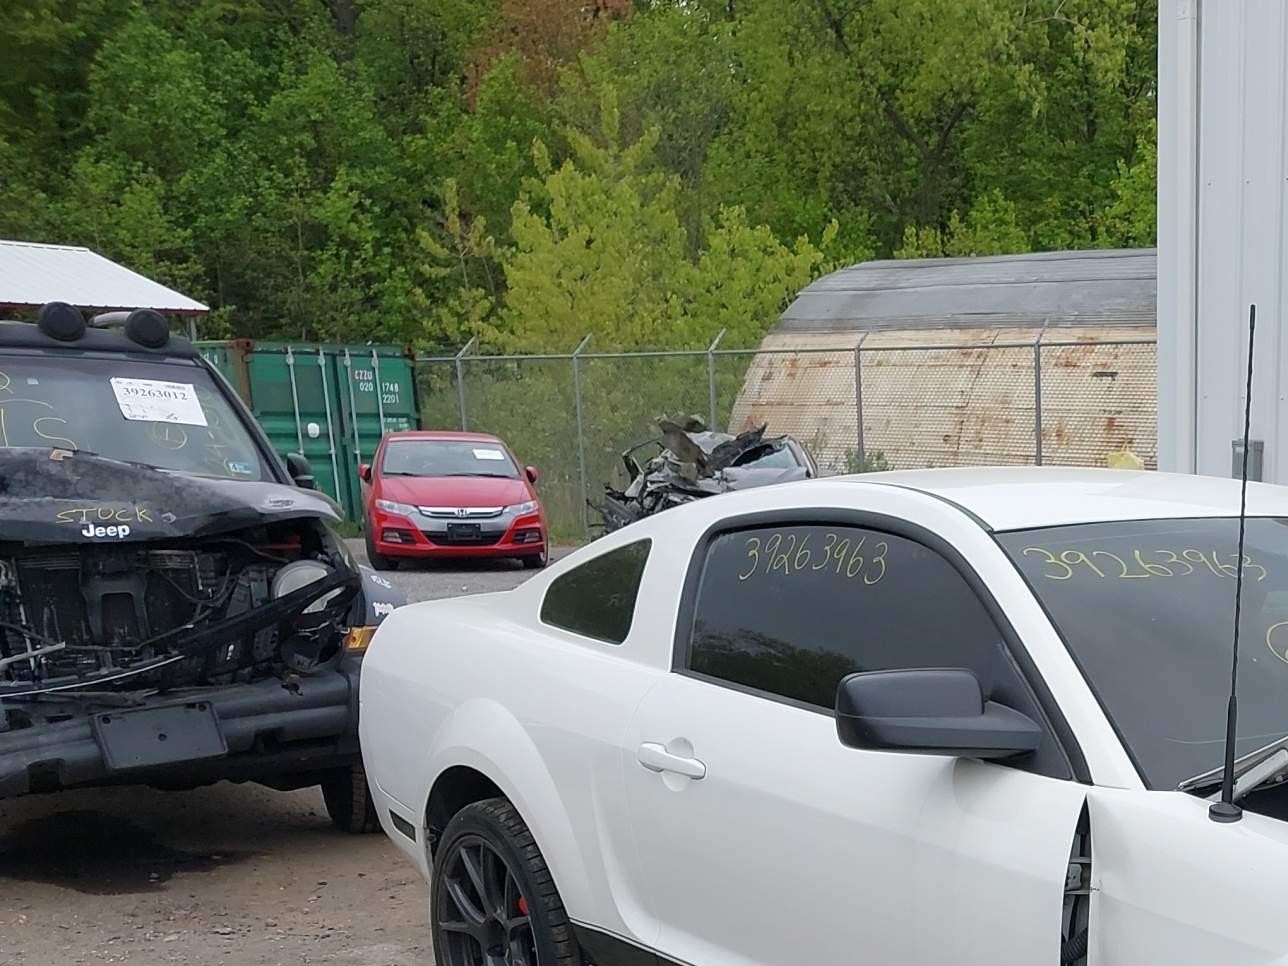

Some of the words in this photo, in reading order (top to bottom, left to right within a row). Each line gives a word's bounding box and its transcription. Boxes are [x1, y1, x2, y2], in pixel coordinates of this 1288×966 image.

[122, 386, 188, 401] 39263012
[55, 507, 153, 524] STUCK
[81, 523, 131, 539] Jeep
[738, 533, 889, 585] 39263963
[1023, 547, 1267, 582] 39263963
